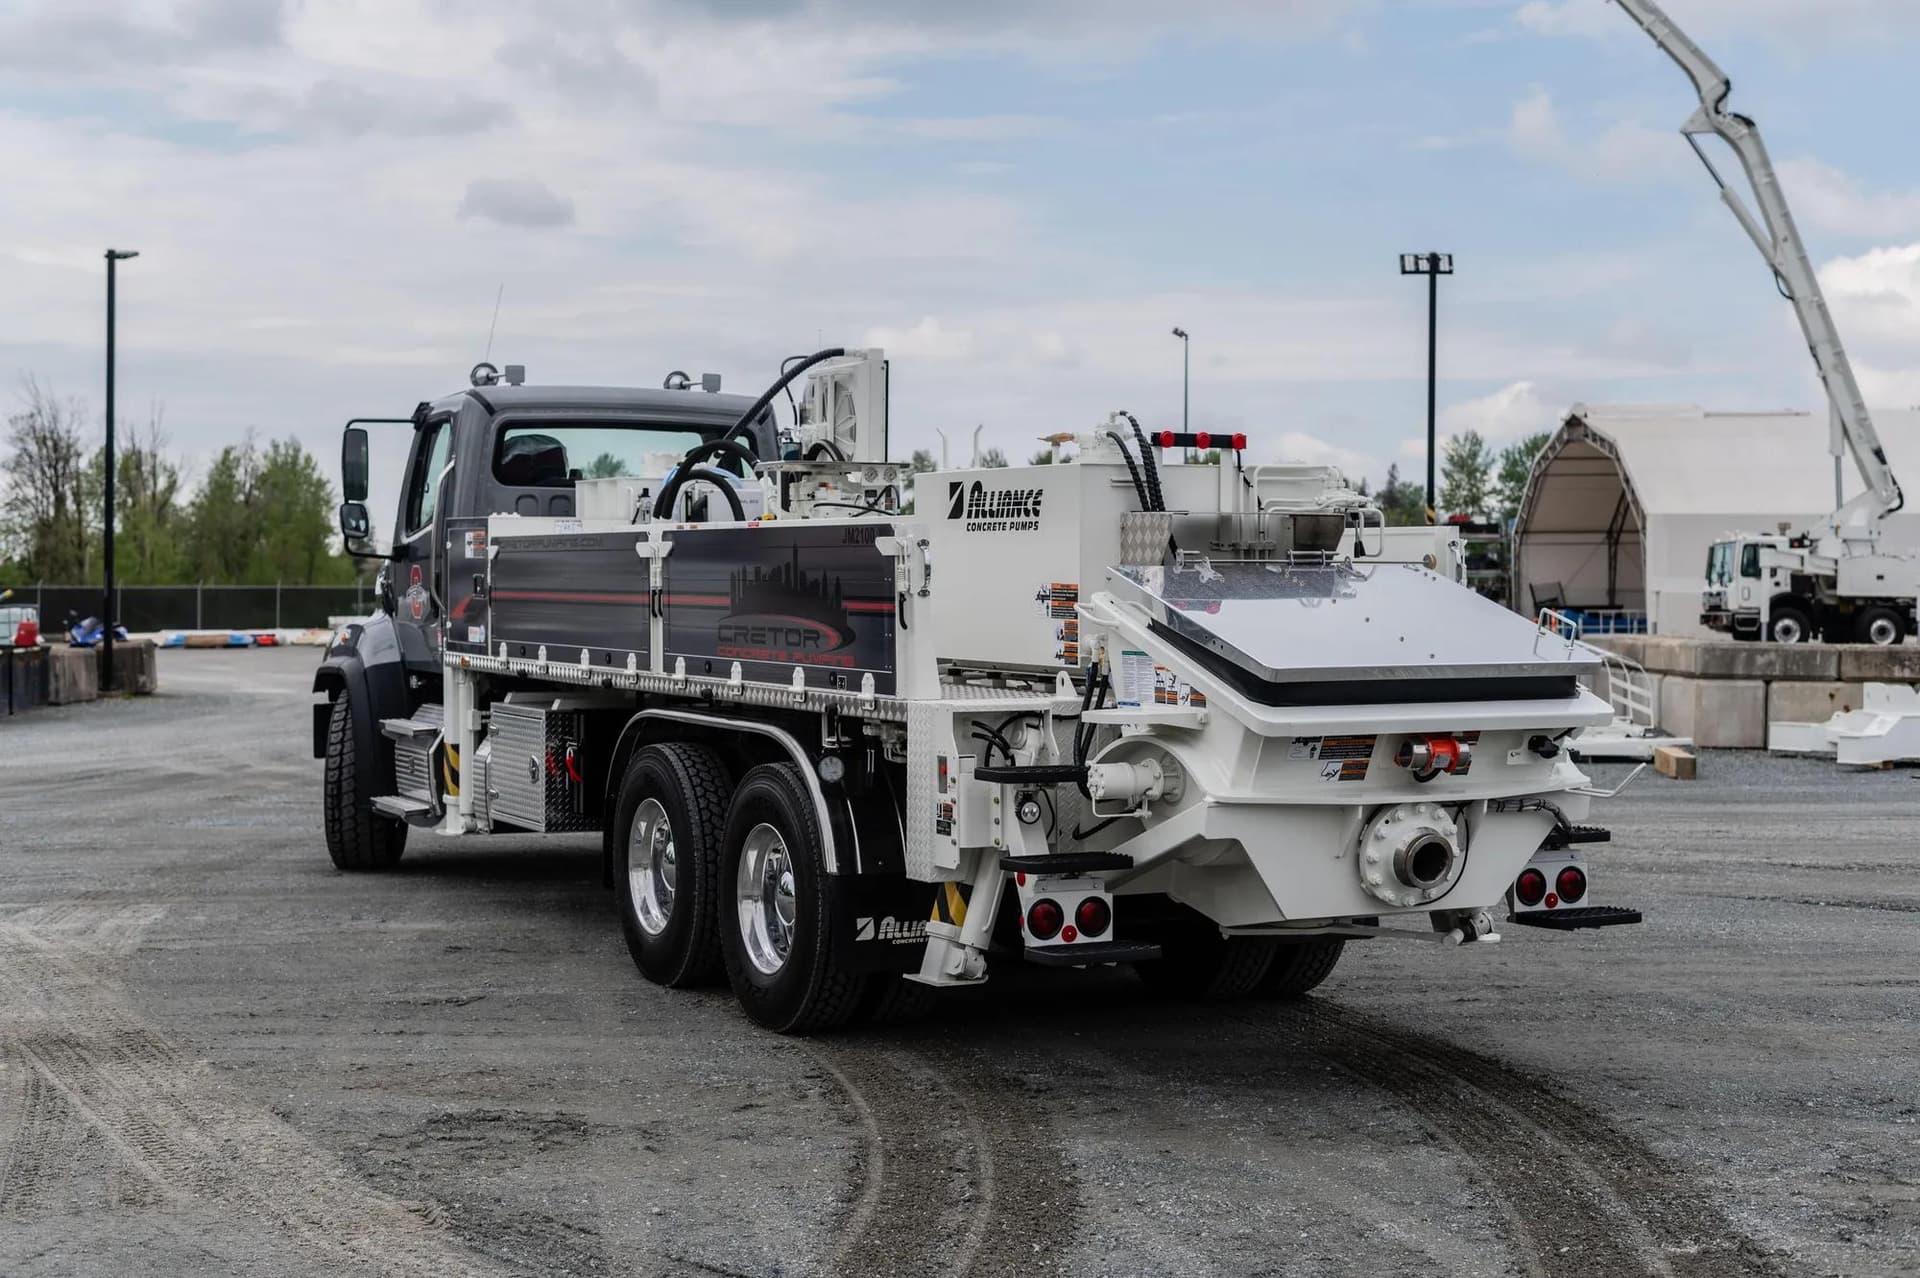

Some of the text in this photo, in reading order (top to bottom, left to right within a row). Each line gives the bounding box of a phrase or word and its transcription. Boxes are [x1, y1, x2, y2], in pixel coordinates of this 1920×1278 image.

[966, 480, 1043, 519] ALLIANCE
[966, 520, 1039, 532] CONCRETE PUMPS
[718, 624, 820, 648] CRETOR
[878, 916, 927, 939] ALLIA
